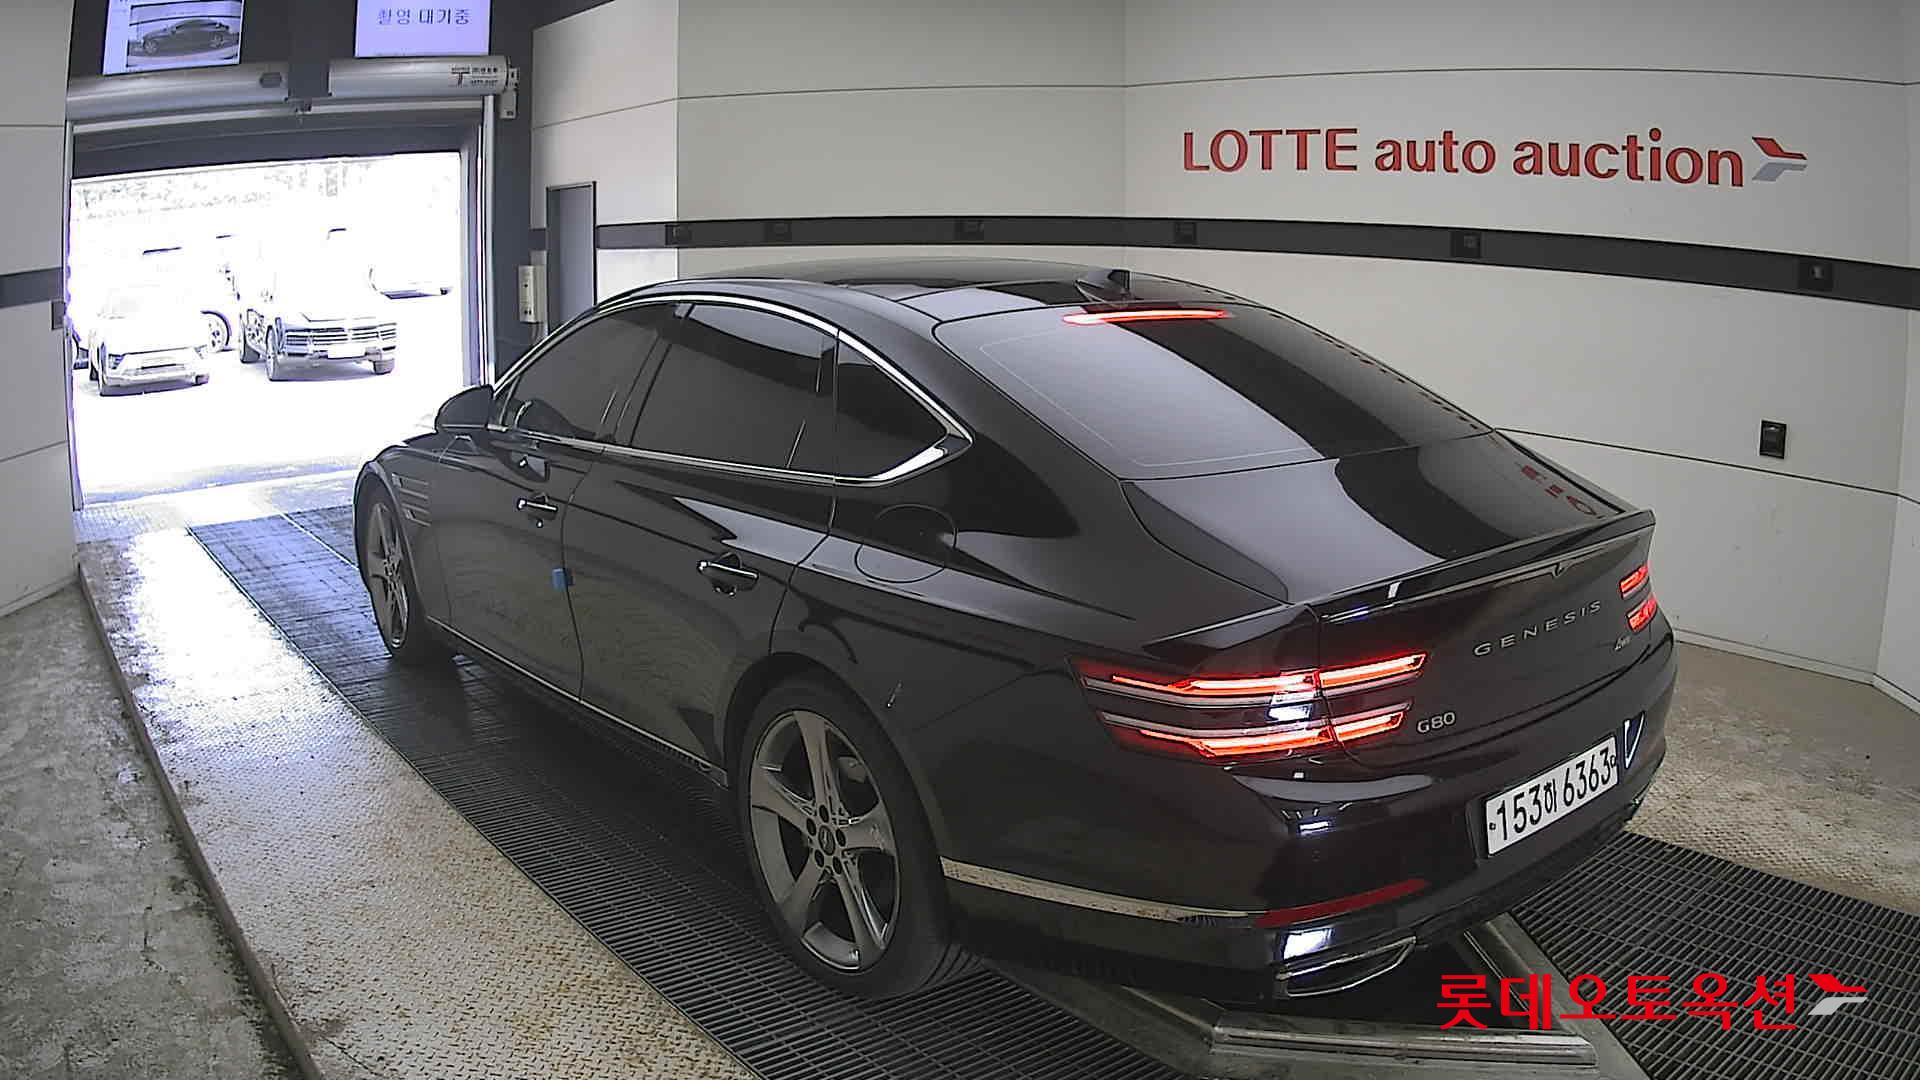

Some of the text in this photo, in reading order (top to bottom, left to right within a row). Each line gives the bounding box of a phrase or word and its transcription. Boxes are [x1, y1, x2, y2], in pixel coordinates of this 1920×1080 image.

[419, 8, 469, 25] 대기중
[1183, 128, 1744, 187] LOTTE auto auction
[1473, 600, 1601, 656] GENESIS
[1416, 711, 1456, 733] G80
